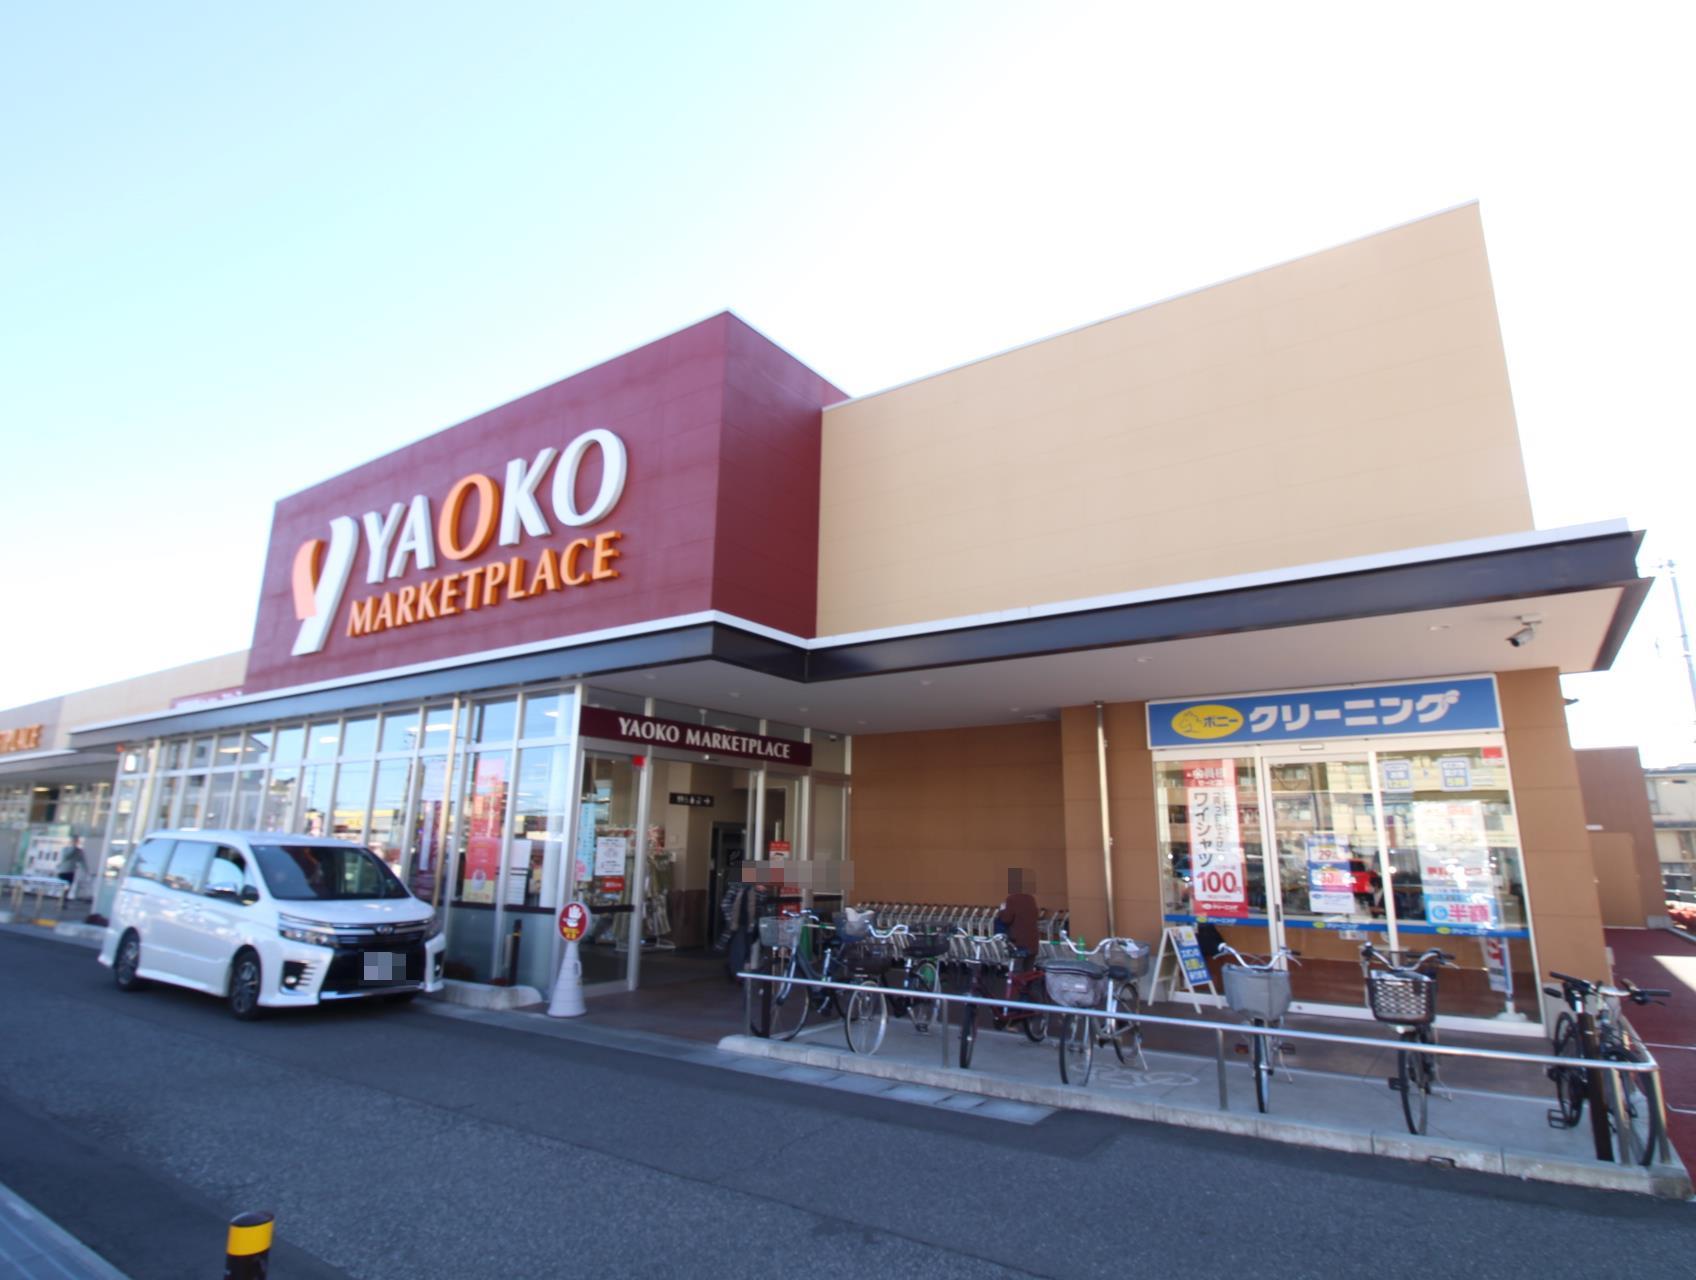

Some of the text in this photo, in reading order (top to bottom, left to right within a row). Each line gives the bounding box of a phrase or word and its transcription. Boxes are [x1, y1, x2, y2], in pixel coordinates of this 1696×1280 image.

[363, 428, 627, 584] YAOKO
[346, 530, 622, 637] MARKETPLACE
[618, 717, 791, 759] YAOKO MARKETPLACE
[1249, 690, 1461, 733] クリーニング
[1194, 791, 1213, 868] ワイシャツ
